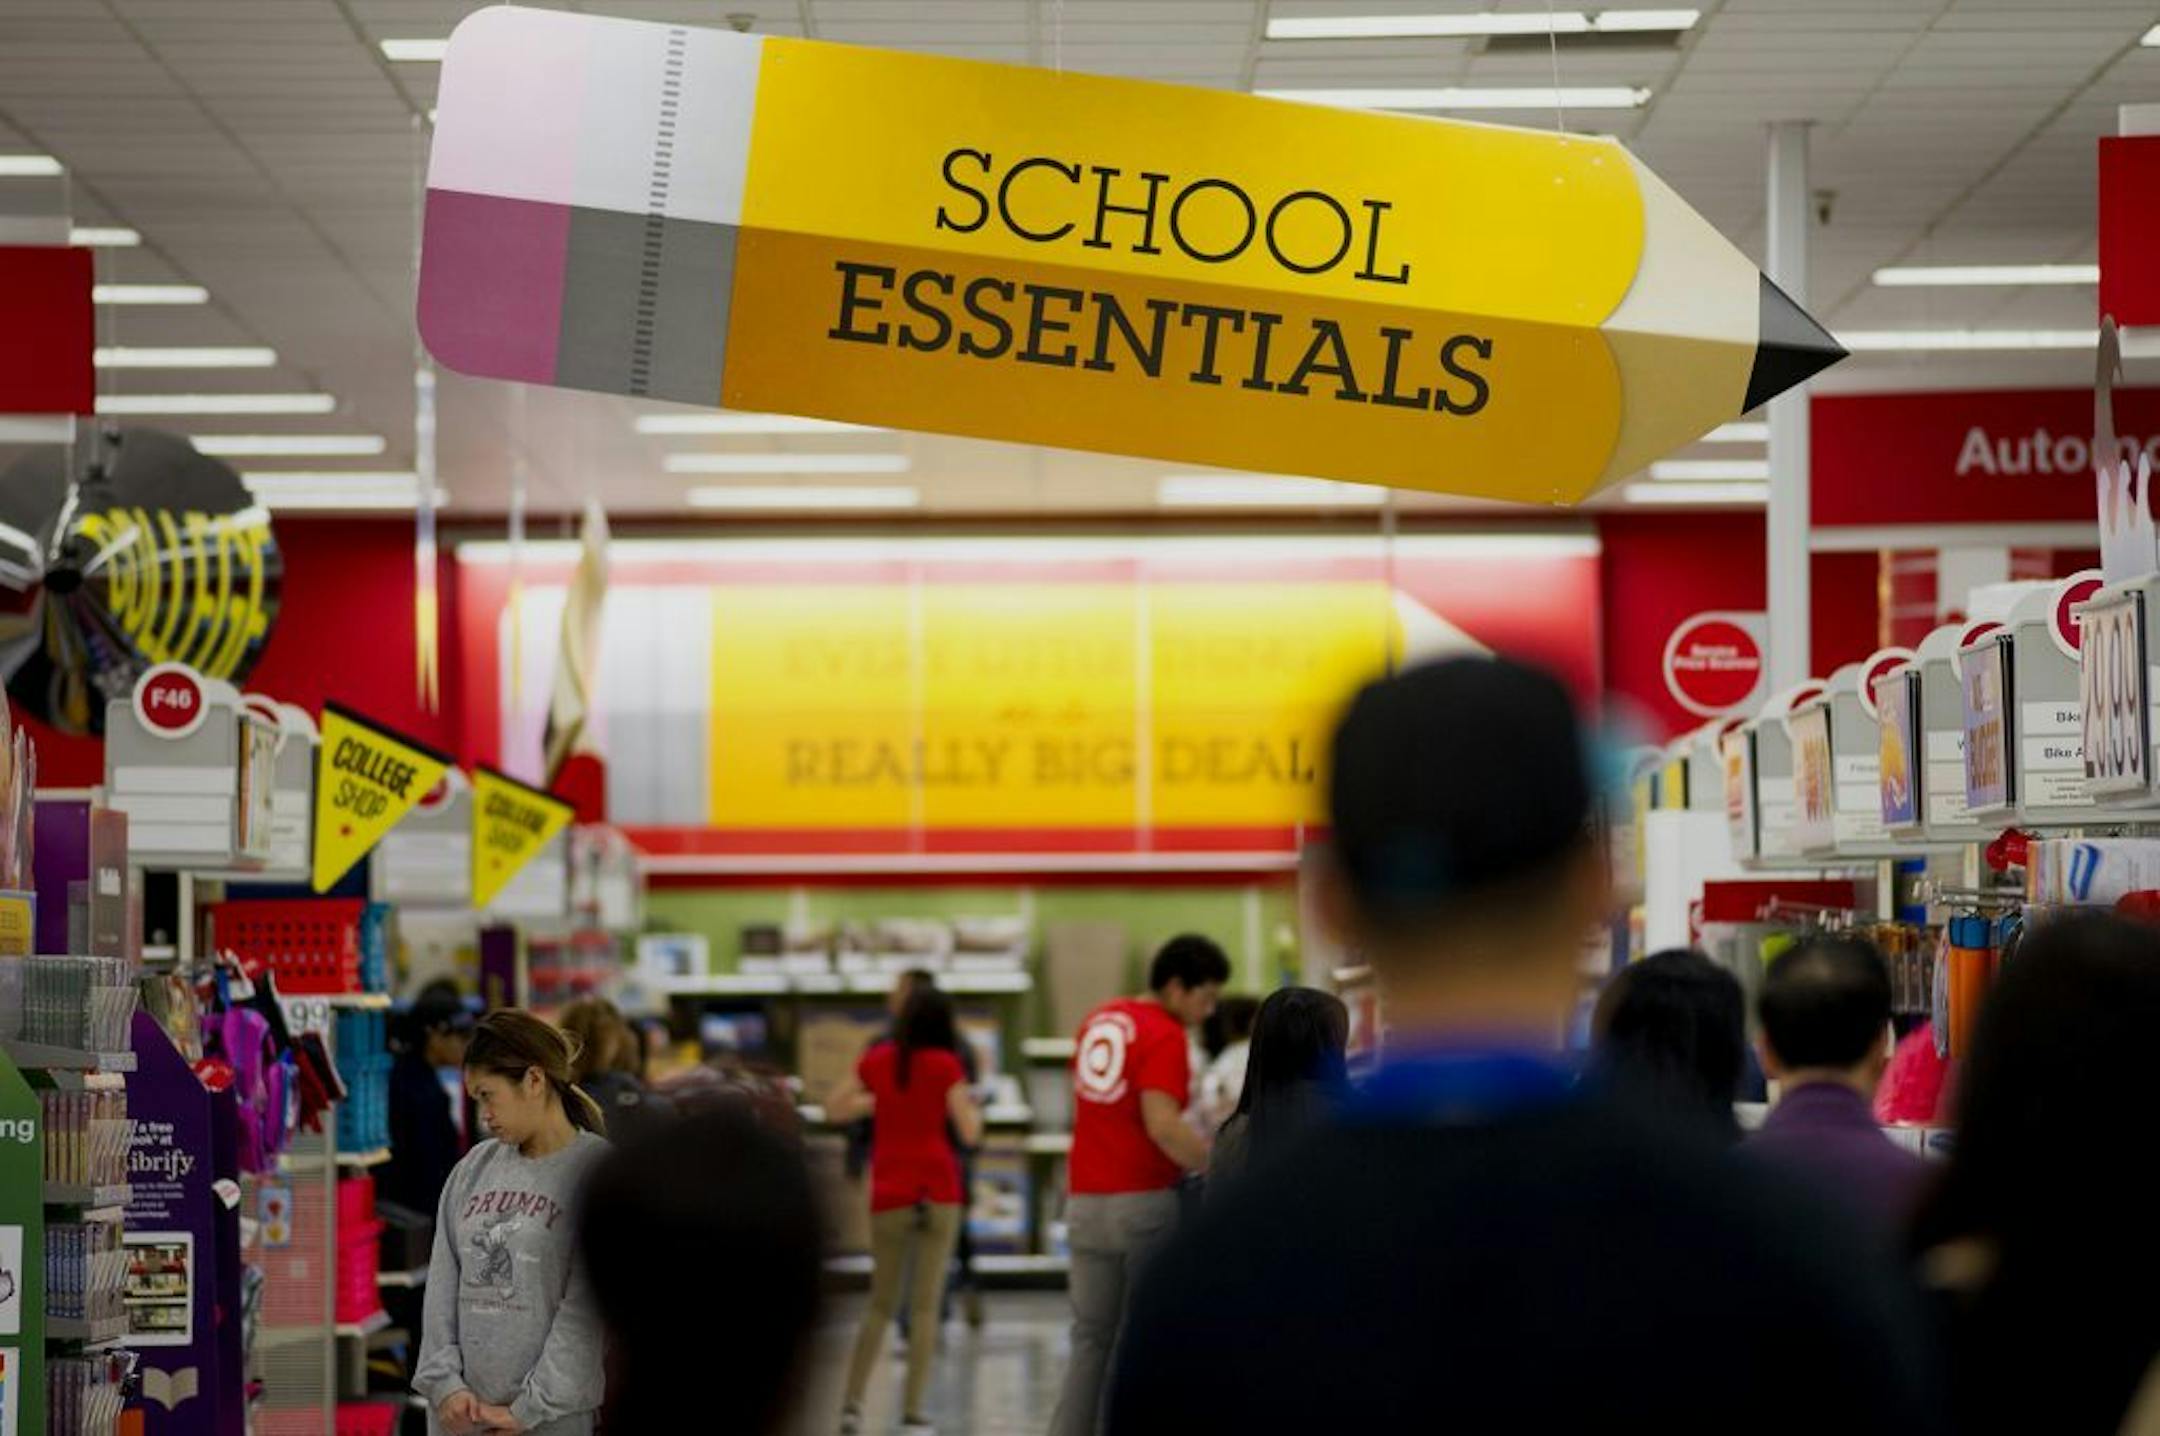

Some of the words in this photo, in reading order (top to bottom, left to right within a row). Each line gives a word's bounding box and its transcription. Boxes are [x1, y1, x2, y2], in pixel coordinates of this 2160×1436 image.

[935, 148, 1410, 285] SCHOOL
[828, 261, 1492, 416] ESSENTIALS
[151, 687, 193, 709] F46
[333, 737, 418, 800] COLLEGE
[783, 736, 1010, 785] REALLY
[1032, 736, 1136, 785] BIG
[1160, 736, 1316, 785] DEAL
[334, 779, 389, 819] SHOP
[484, 792, 548, 835] COLLEGE
[0, 1121, 35, 1144] ng
[131, 1148, 194, 1181] ibrify
[463, 1190, 562, 1229] GRUMPY
